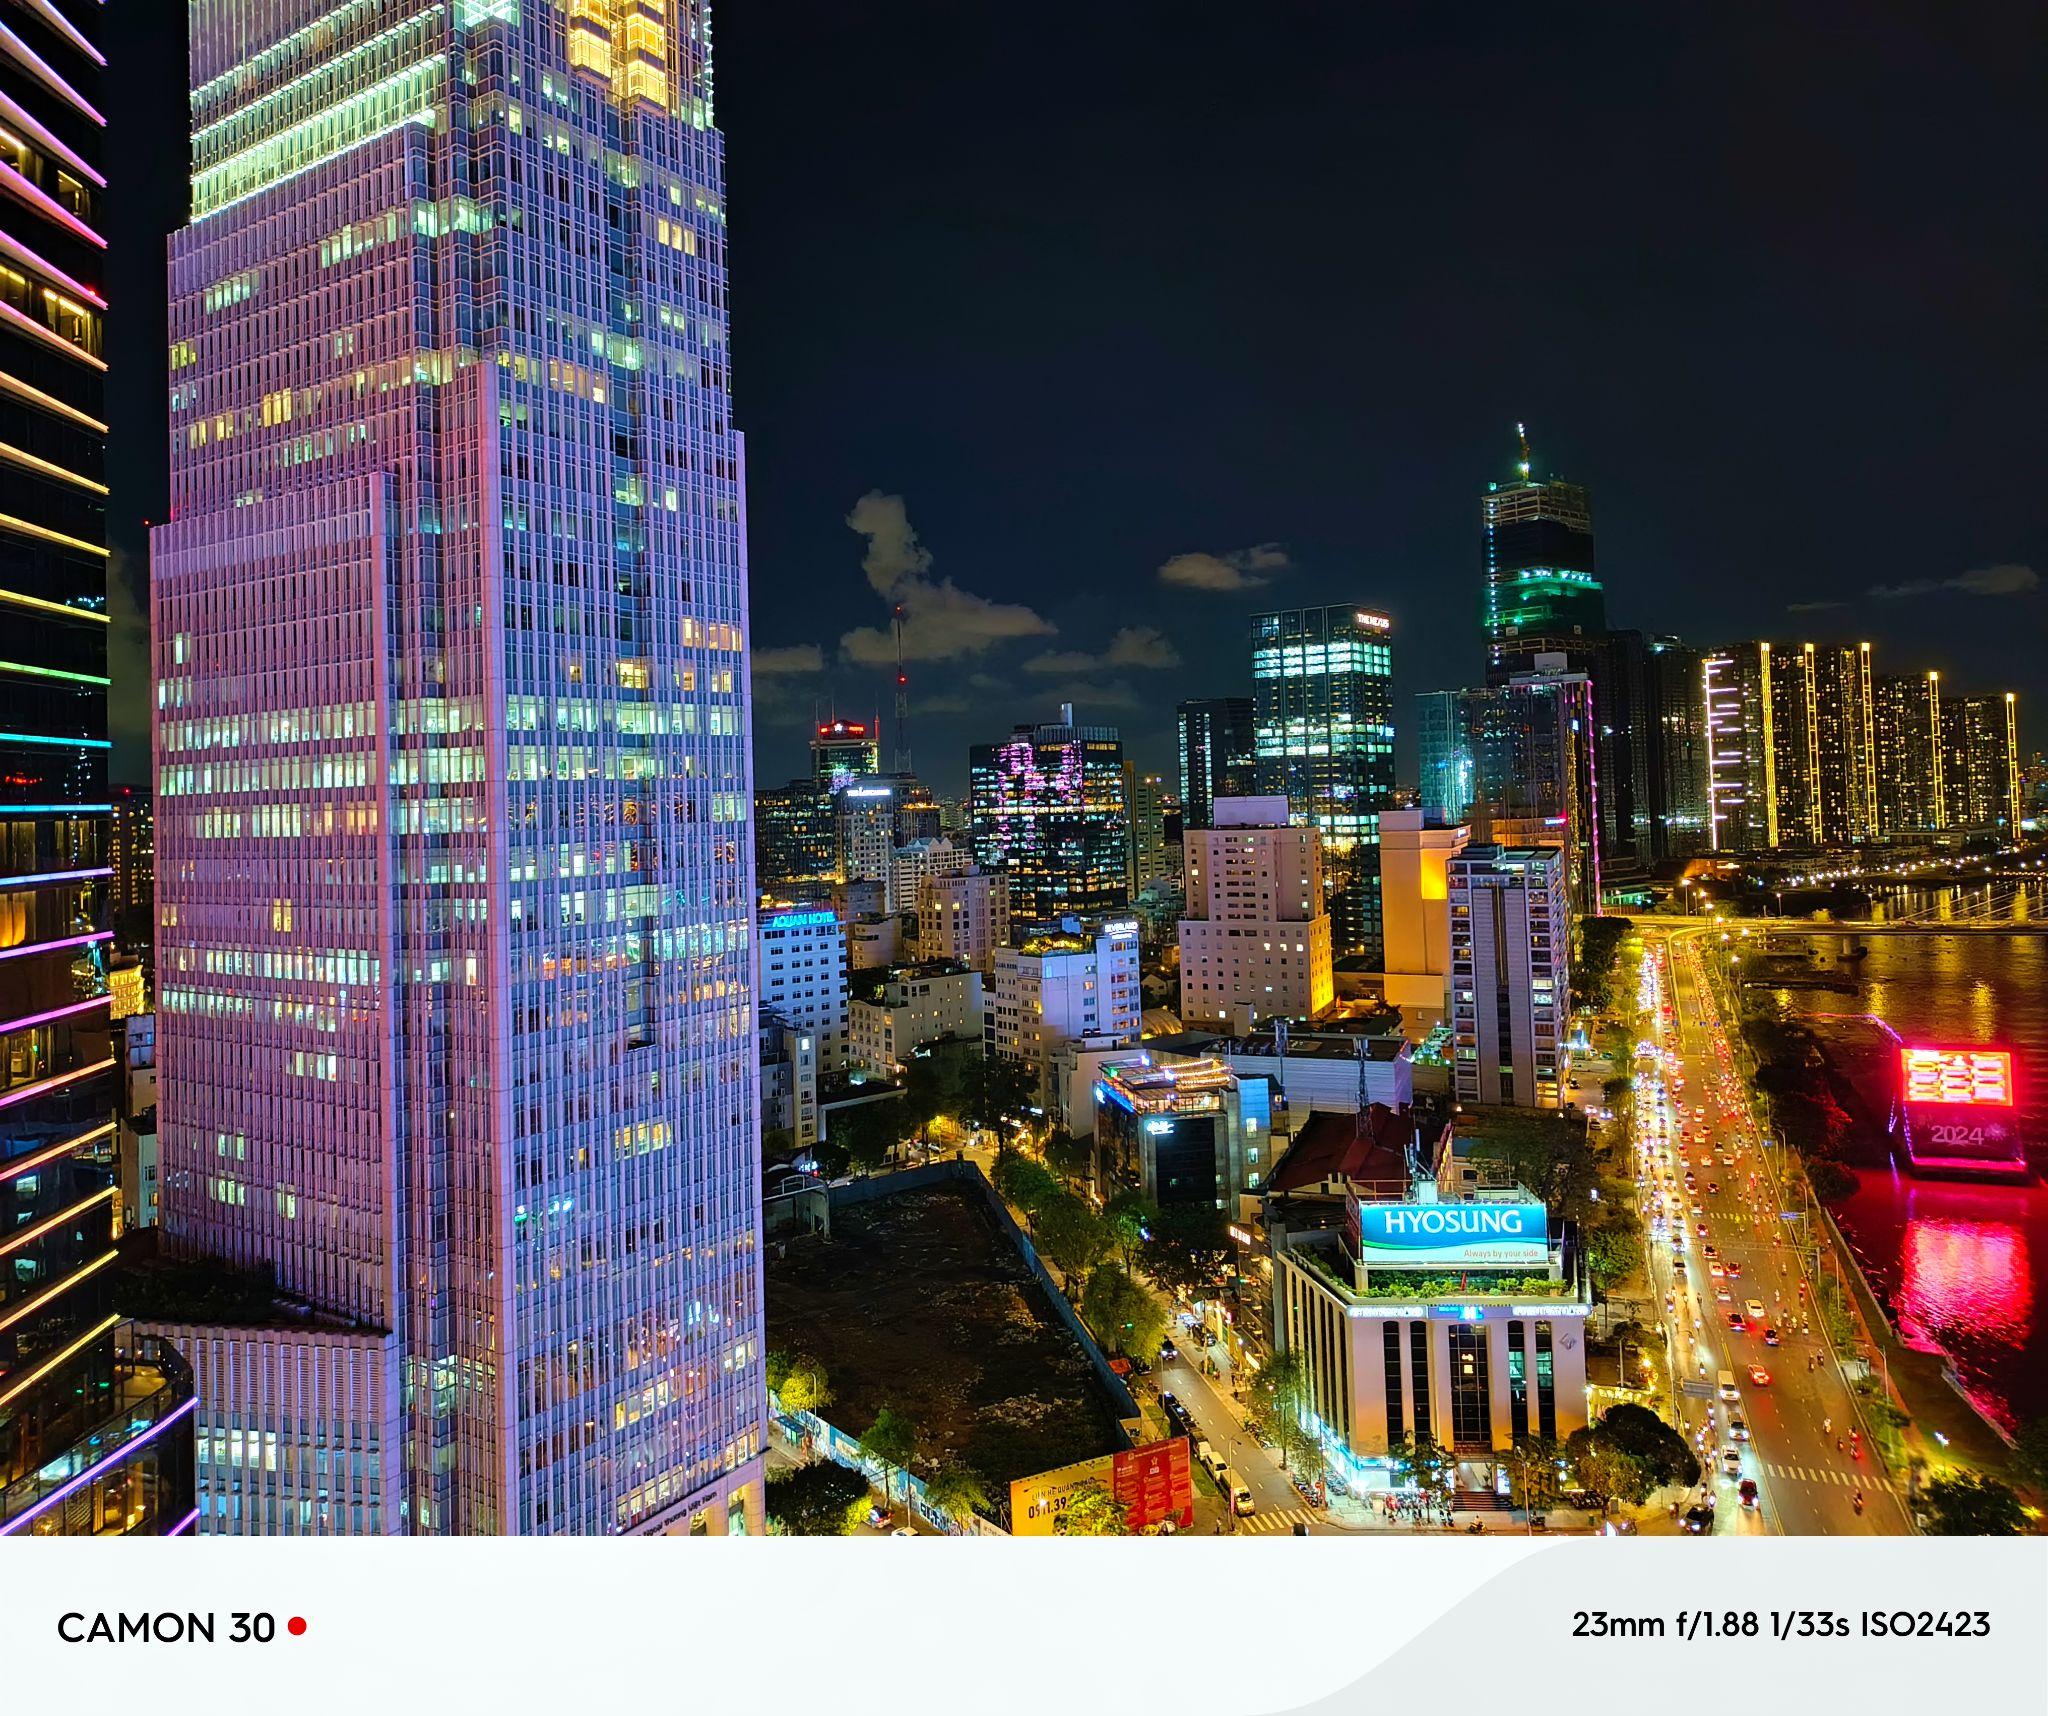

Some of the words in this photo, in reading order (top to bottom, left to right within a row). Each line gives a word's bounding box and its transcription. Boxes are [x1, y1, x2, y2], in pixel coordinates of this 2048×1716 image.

[808, 911, 836, 925] HOTEL
[1931, 1125, 1984, 1145] 2024
[1384, 1209, 1522, 1234] HYOSUNG
[1464, 1249, 1492, 1259] Always
[1492, 1250, 1501, 1258] by
[1504, 1250, 1521, 1259] your
[1523, 1249, 1538, 1257] side
